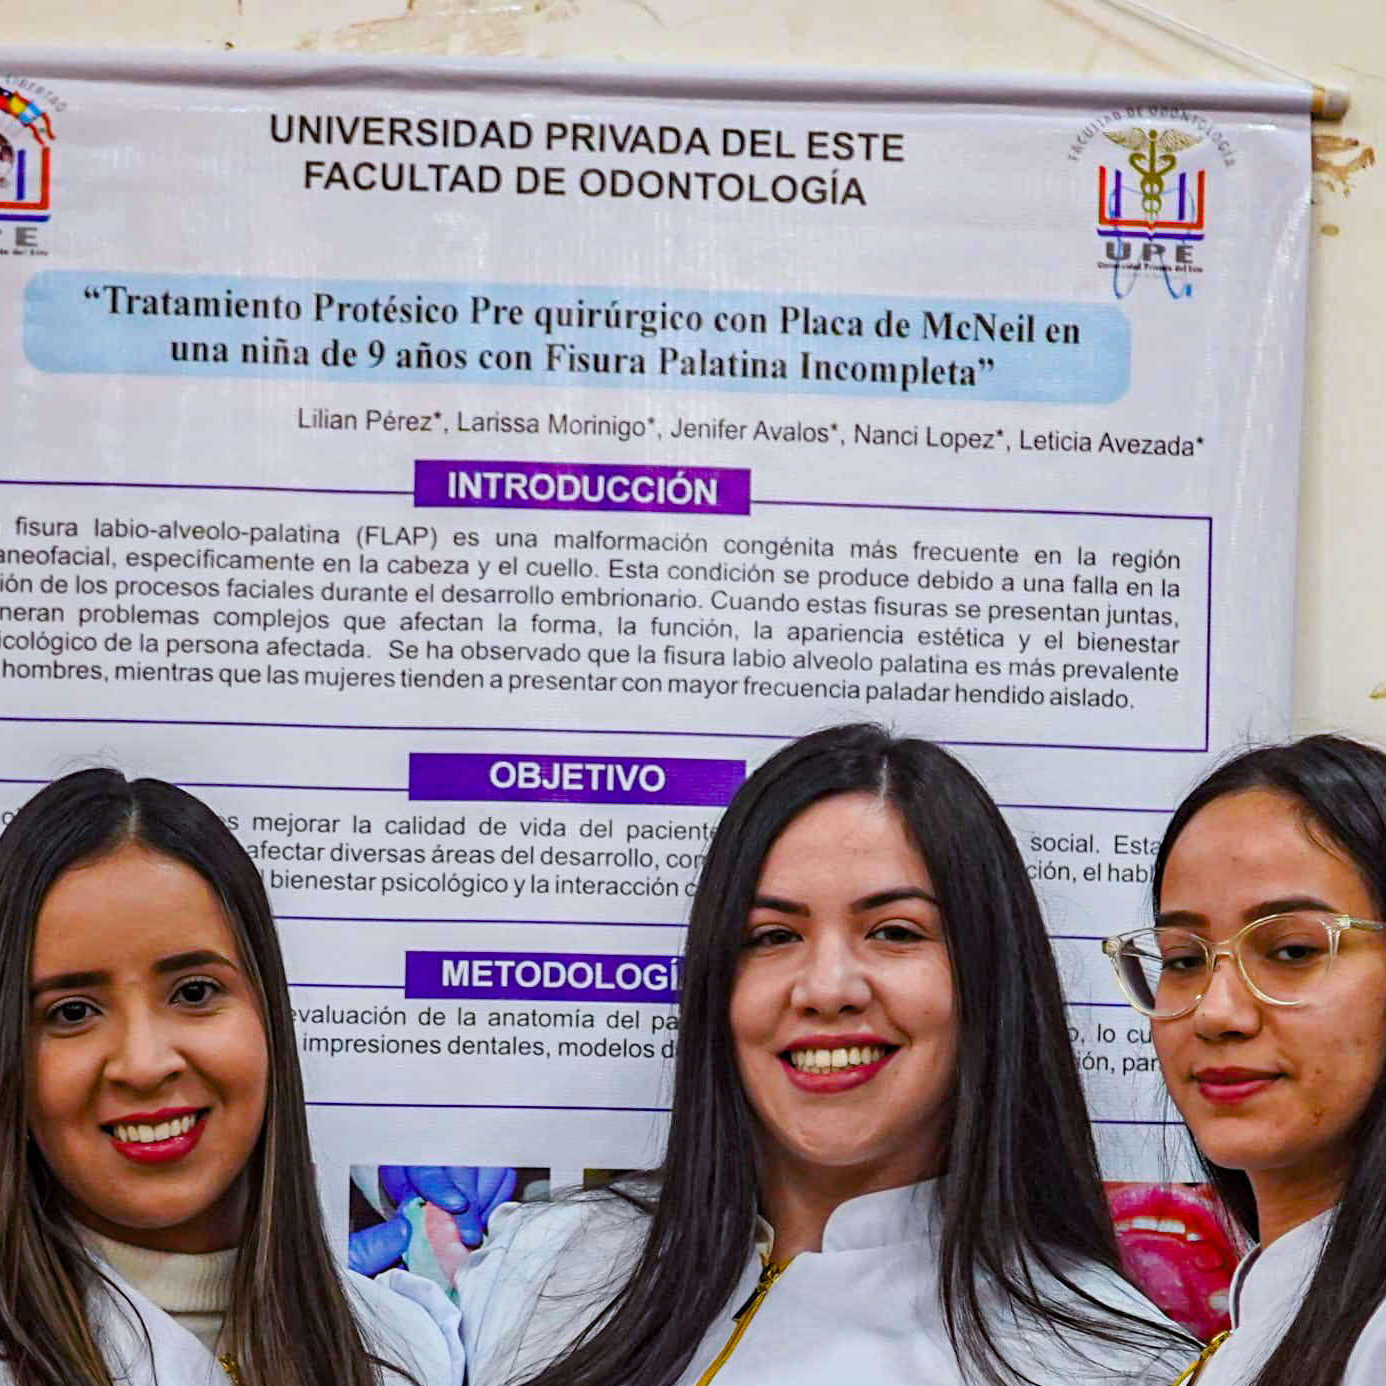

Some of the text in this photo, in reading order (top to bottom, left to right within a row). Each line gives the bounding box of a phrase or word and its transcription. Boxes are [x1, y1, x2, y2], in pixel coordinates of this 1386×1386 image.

[269, 112, 906, 164] UNIVERSIDAD PRIVADA DEL ESTE
[303, 159, 868, 207] FACULTAD DE ODONTOLOGÍA
[1105, 241, 1194, 264] UPE
[313, 292, 460, 326] Protésico
[469, 295, 525, 327] Pre
[533, 297, 704, 339] quirúrgico
[713, 311, 768, 335] con
[779, 305, 864, 339] Placa
[873, 308, 912, 340] de
[921, 310, 1036, 344] McNeil
[1044, 322, 1081, 346] en
[169, 335, 996, 393] una niña de 9 años con Fisura Palatina Incompleta”
[297, 406, 358, 431] Lilian
[456, 410, 540, 435] Larissa
[669, 416, 749, 441] Jenifer
[853, 422, 919, 448] Nanci
[1019, 428, 1093, 454] Leticia
[447, 470, 719, 506] INTRODUCCIÓN
[14, 515, 79, 538] fisura
[93, 516, 341, 548] labio-alveolo-palatina
[355, 524, 438, 552] (FLAP)
[452, 530, 481, 548] es
[495, 531, 539, 549] una
[553, 529, 709, 554] malformación
[722, 535, 835, 562] congénita
[849, 538, 899, 561] más
[912, 539, 1020, 565] frecuente
[1033, 548, 1062, 566] en
[1077, 545, 1098, 568] la
[1111, 548, 1181, 575] región
[321, 556, 352, 574] en
[358, 553, 380, 575] la
[386, 553, 470, 576] cabeza
[477, 559, 492, 581] y
[497, 555, 519, 577] el
[524, 556, 600, 579] cuello.
[608, 557, 660, 581] Esta
[666, 561, 776, 585] condición
[782, 568, 811, 586] se
[817, 566, 910, 591] produce
[916, 568, 994, 592] debido
[1000, 576, 1015, 593] a
[1022, 576, 1065, 594] una
[1072, 573, 1119, 597] falla
[1125, 580, 1154, 599] en
[1160, 577, 1181, 599] la
[39, 573, 70, 595] de
[74, 573, 109, 596] los
[114, 579, 221, 601] procesos
[225, 576, 315, 601] faciales
[320, 580, 409, 604] durante
[414, 582, 435, 604] el
[440, 583, 555, 606] desarrollo
[560, 586, 704, 610] embrionario.
[709, 588, 801, 614] Cuando
[805, 595, 868, 616] estas
[873, 594, 950, 619] fisuras
[954, 602, 982, 620] se
[987, 602, 1101, 625] presentan
[1104, 602, 1180, 630] juntas,
[77, 603, 201, 629] problemas
[212, 607, 331, 635] complejos
[342, 614, 387, 636] que
[398, 610, 484, 633] afectan
[497, 611, 518, 633] la
[530, 612, 603, 638] forma,
[617, 615, 637, 637] la
[649, 615, 740, 642] función,
[753, 619, 774, 641] la
[786, 622, 905, 647] apariencia
[916, 625, 1005, 649] estética
[1017, 632, 1032, 655] y
[1043, 629, 1064, 651] el
[1076, 630, 1181, 655] bienestar
[102, 631, 133, 653] de
[138, 632, 160, 654] la
[165, 637, 260, 659] persona
[265, 635, 372, 660] afectada.
[387, 638, 420, 661] Se
[425, 639, 454, 661] ha
[459, 639, 582, 664] observado
[586, 647, 631, 669] que
[636, 643, 657, 665] la
[662, 643, 726, 667] fisura
[732, 646, 787, 670] labio
[791, 649, 874, 673] alveolo
[879, 652, 969, 678] palatina
[489, 761, 667, 792] OBJETIVO
[252, 812, 613, 839] mejorar la calidad de vida del
[1029, 832, 1100, 854] social.
[246, 839, 660, 872] afectar diversas áreas del desarrollo,
[270, 868, 680, 899] bienestar psicológico y la interacción
[442, 957, 682, 992] METODOLOGÍ
[417, 1006, 447, 1027] de
[457, 1006, 477, 1027] la
[487, 1008, 595, 1029] anatomía
[605, 1009, 641, 1031] del
[302, 1031, 656, 1060] impresiones dentales, modelos
